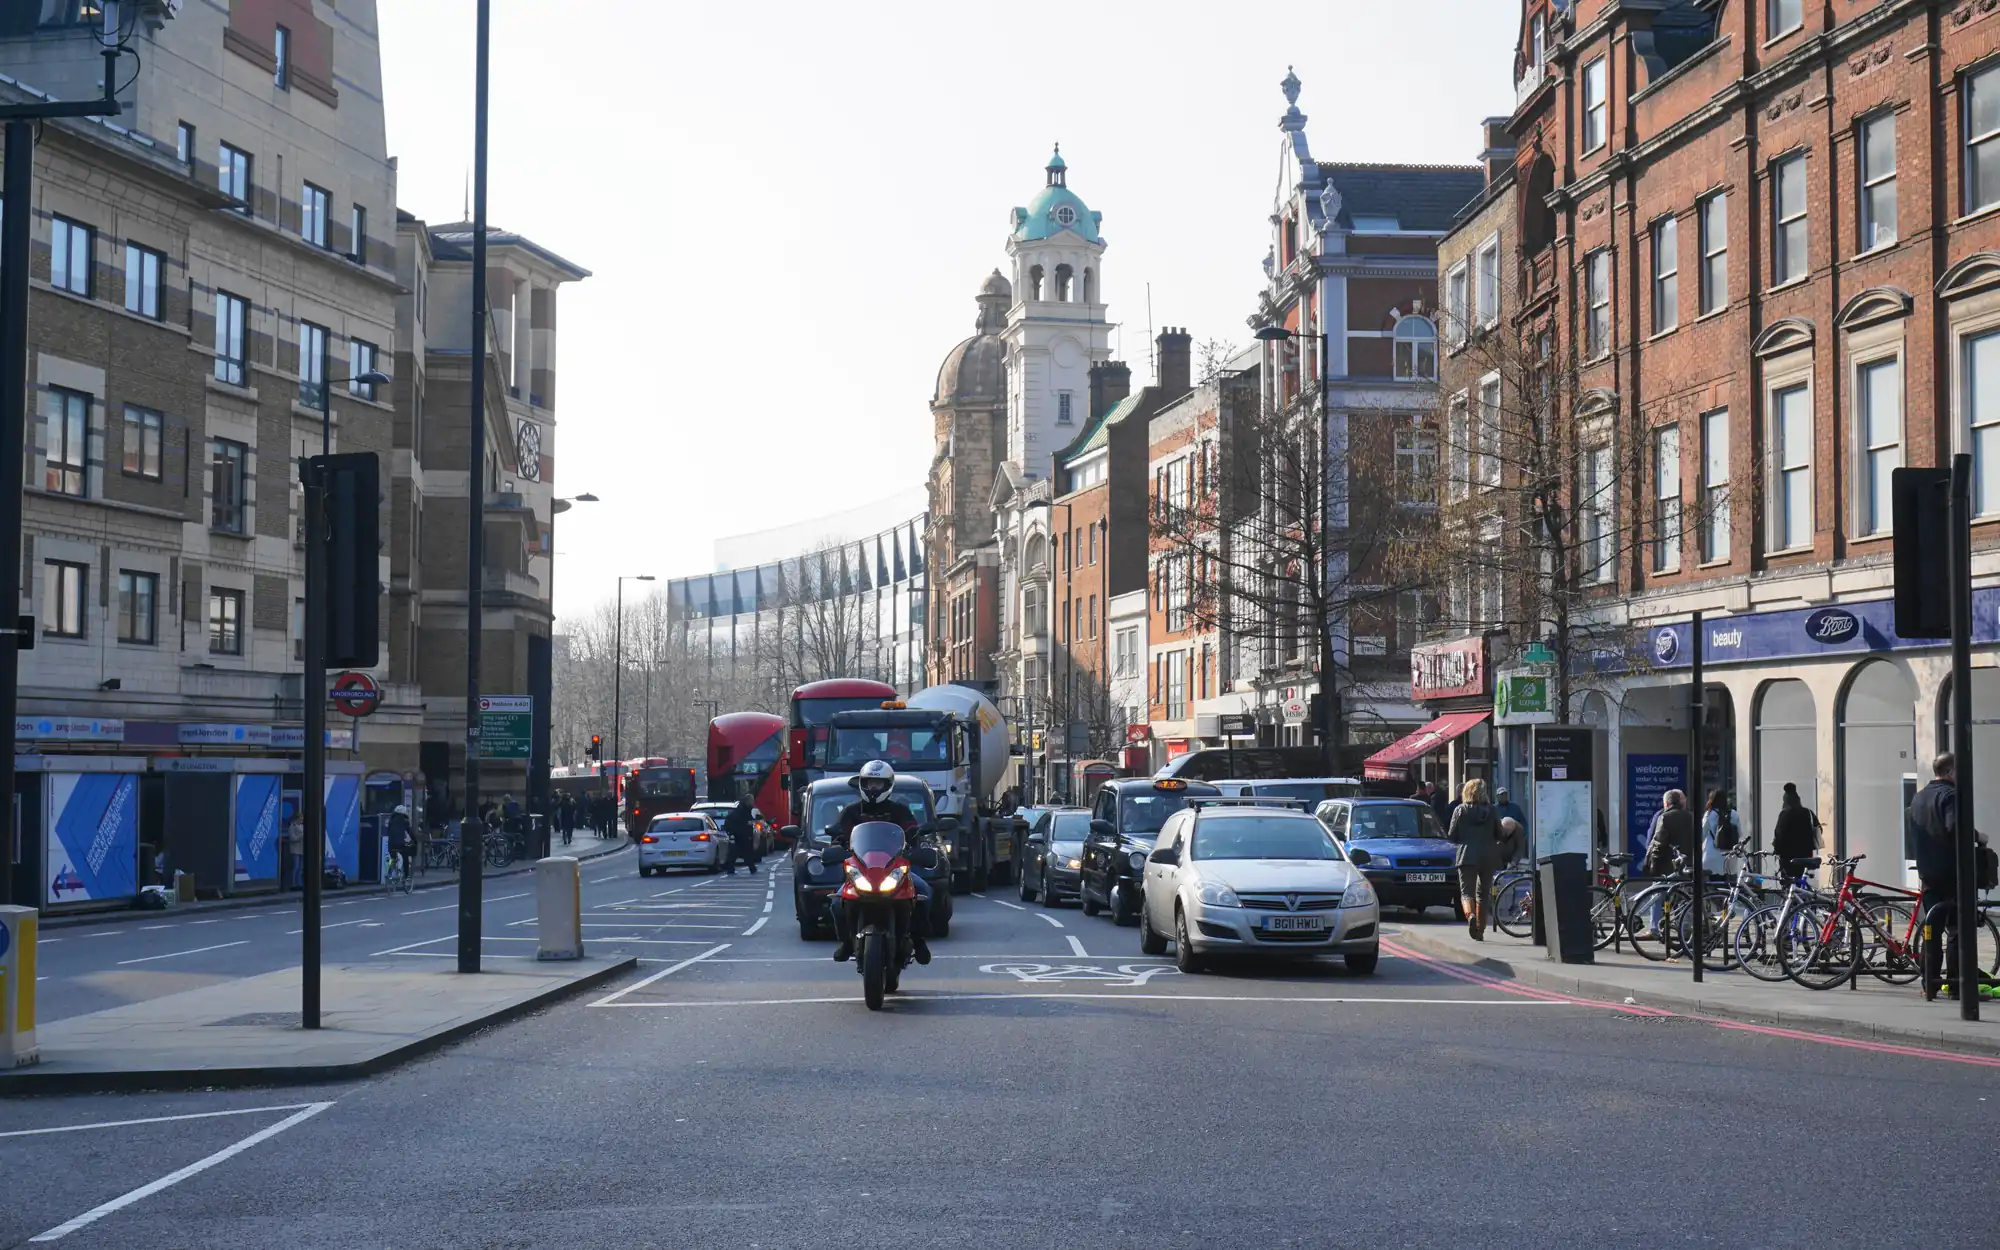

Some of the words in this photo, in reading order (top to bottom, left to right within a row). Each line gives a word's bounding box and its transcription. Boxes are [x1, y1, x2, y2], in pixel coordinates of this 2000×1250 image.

[1815, 615, 1853, 637] Boots
[1713, 628, 1742, 648] beauty
[743, 763, 757, 773] 73
[1635, 764, 1679, 773] welcome
[1407, 873, 1427, 881] R847
[1274, 918, 1295, 929] BG11
[1296, 918, 1318, 929] HWU
